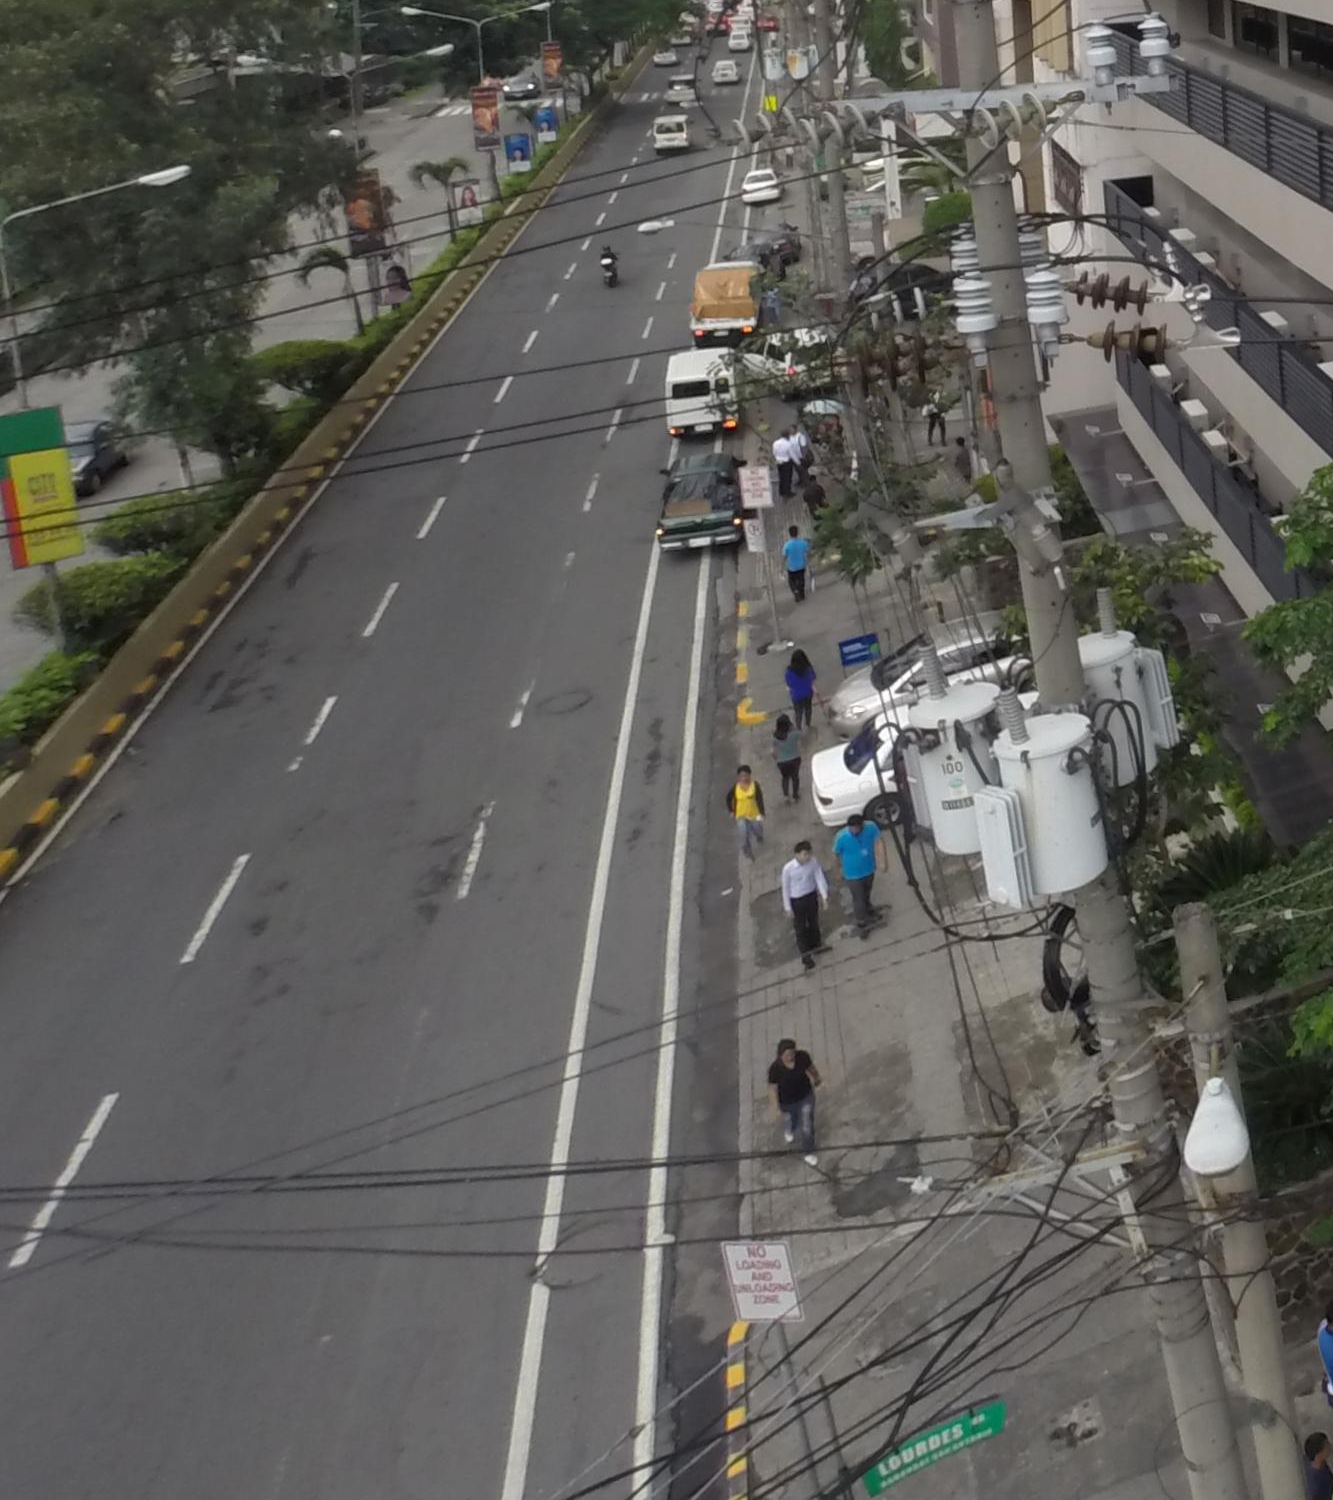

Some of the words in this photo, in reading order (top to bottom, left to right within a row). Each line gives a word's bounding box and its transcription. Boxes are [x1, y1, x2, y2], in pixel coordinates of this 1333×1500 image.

[941, 761, 964, 775] 100
[746, 1246, 767, 1259] NO
[736, 1259, 782, 1271] LOADING
[751, 1271, 773, 1282] AND
[753, 1294, 781, 1305] ZONE
[877, 1423, 964, 1477] LOURDES
